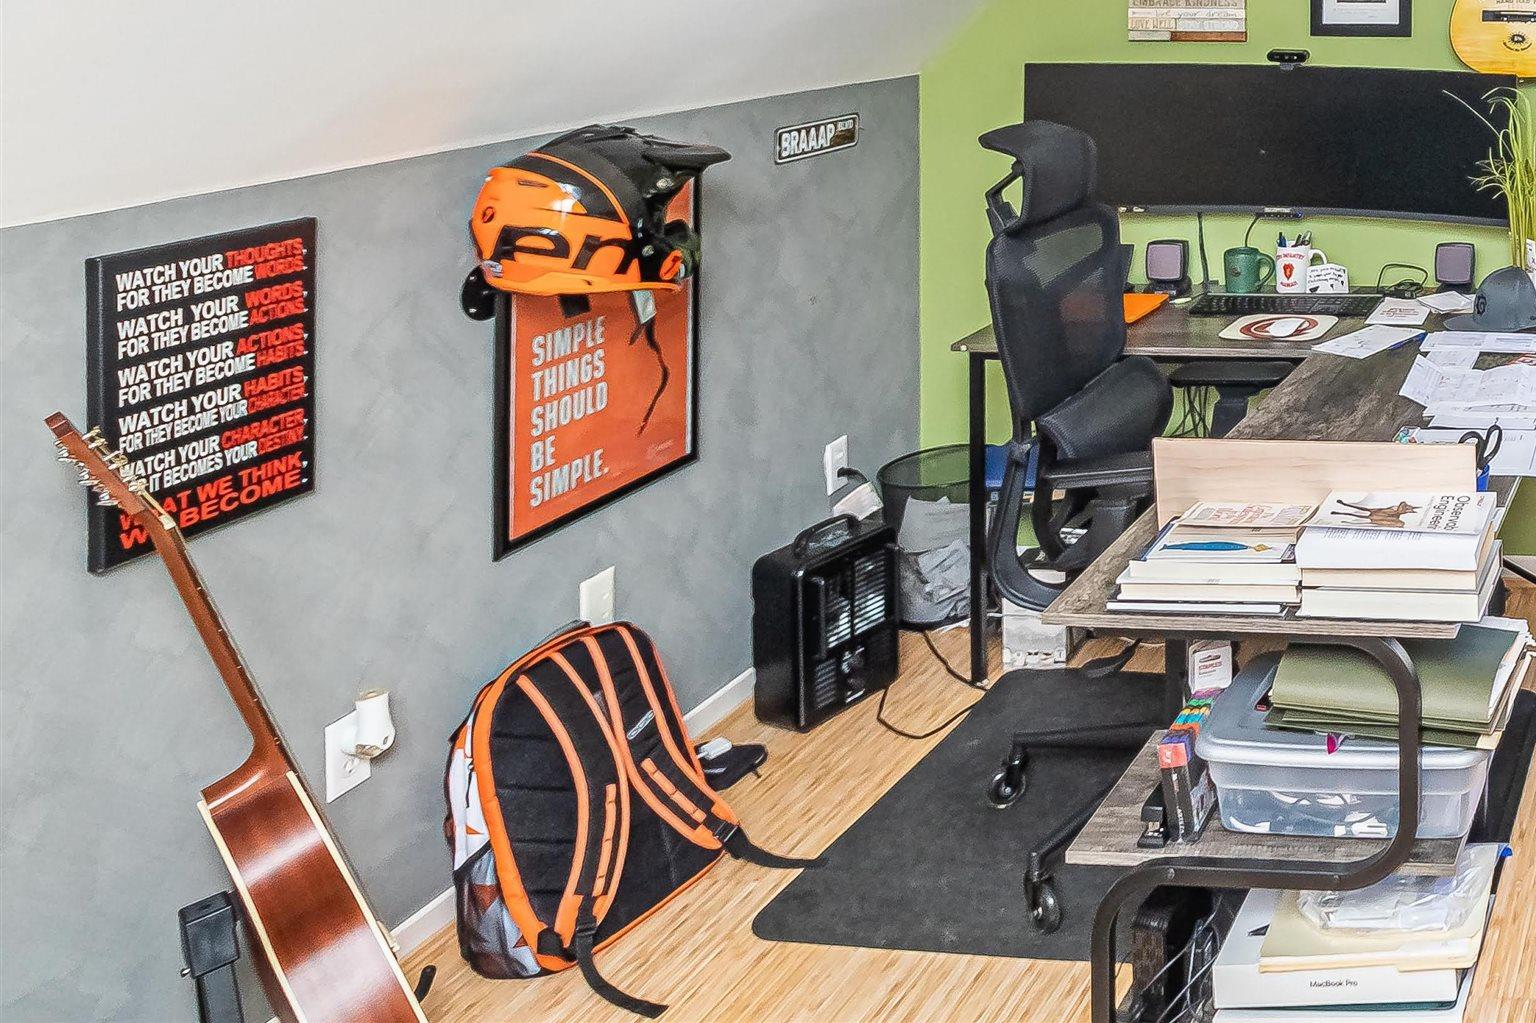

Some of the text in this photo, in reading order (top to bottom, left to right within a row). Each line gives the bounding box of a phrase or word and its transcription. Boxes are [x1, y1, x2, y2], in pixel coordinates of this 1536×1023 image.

[781, 123, 835, 157] BRAAAP
[115, 238, 307, 292] WATCH YOUR THOUGHTS,
[117, 291, 150, 312] FOR
[152, 279, 191, 303] THEY
[193, 266, 254, 294] BECOME
[117, 280, 308, 340] WATCH YOUR WORDS,
[118, 338, 149, 360] FOR
[151, 325, 190, 351] THEY
[191, 310, 249, 341] BECOME
[118, 323, 308, 387] WATCH YOUR ACTIONS,
[531, 315, 606, 367] SIMPLE
[118, 385, 152, 408] FOR
[154, 372, 194, 397] THEY
[196, 353, 255, 386] BECOME
[118, 366, 308, 435] WATCH YOUR HABITS,
[532, 348, 606, 401] THINGS
[119, 434, 143, 455] FOR
[145, 425, 172, 445] THEY
[174, 409, 219, 439] BECOME
[219, 399, 248, 423] YOUR
[530, 381, 609, 437] SHOULD
[119, 408, 308, 479] WATCH YOUR CHARACTER,
[149, 472, 161, 493] IT
[163, 453, 224, 488] BECOMES
[225, 440, 258, 466] YOUR
[530, 435, 556, 473] BE
[119, 451, 308, 530] WAT WE THINK,
[179, 470, 309, 528] BECOME.
[529, 449, 609, 507] SIMPLE.
[1310, 979, 1358, 988] MacBook Pro
